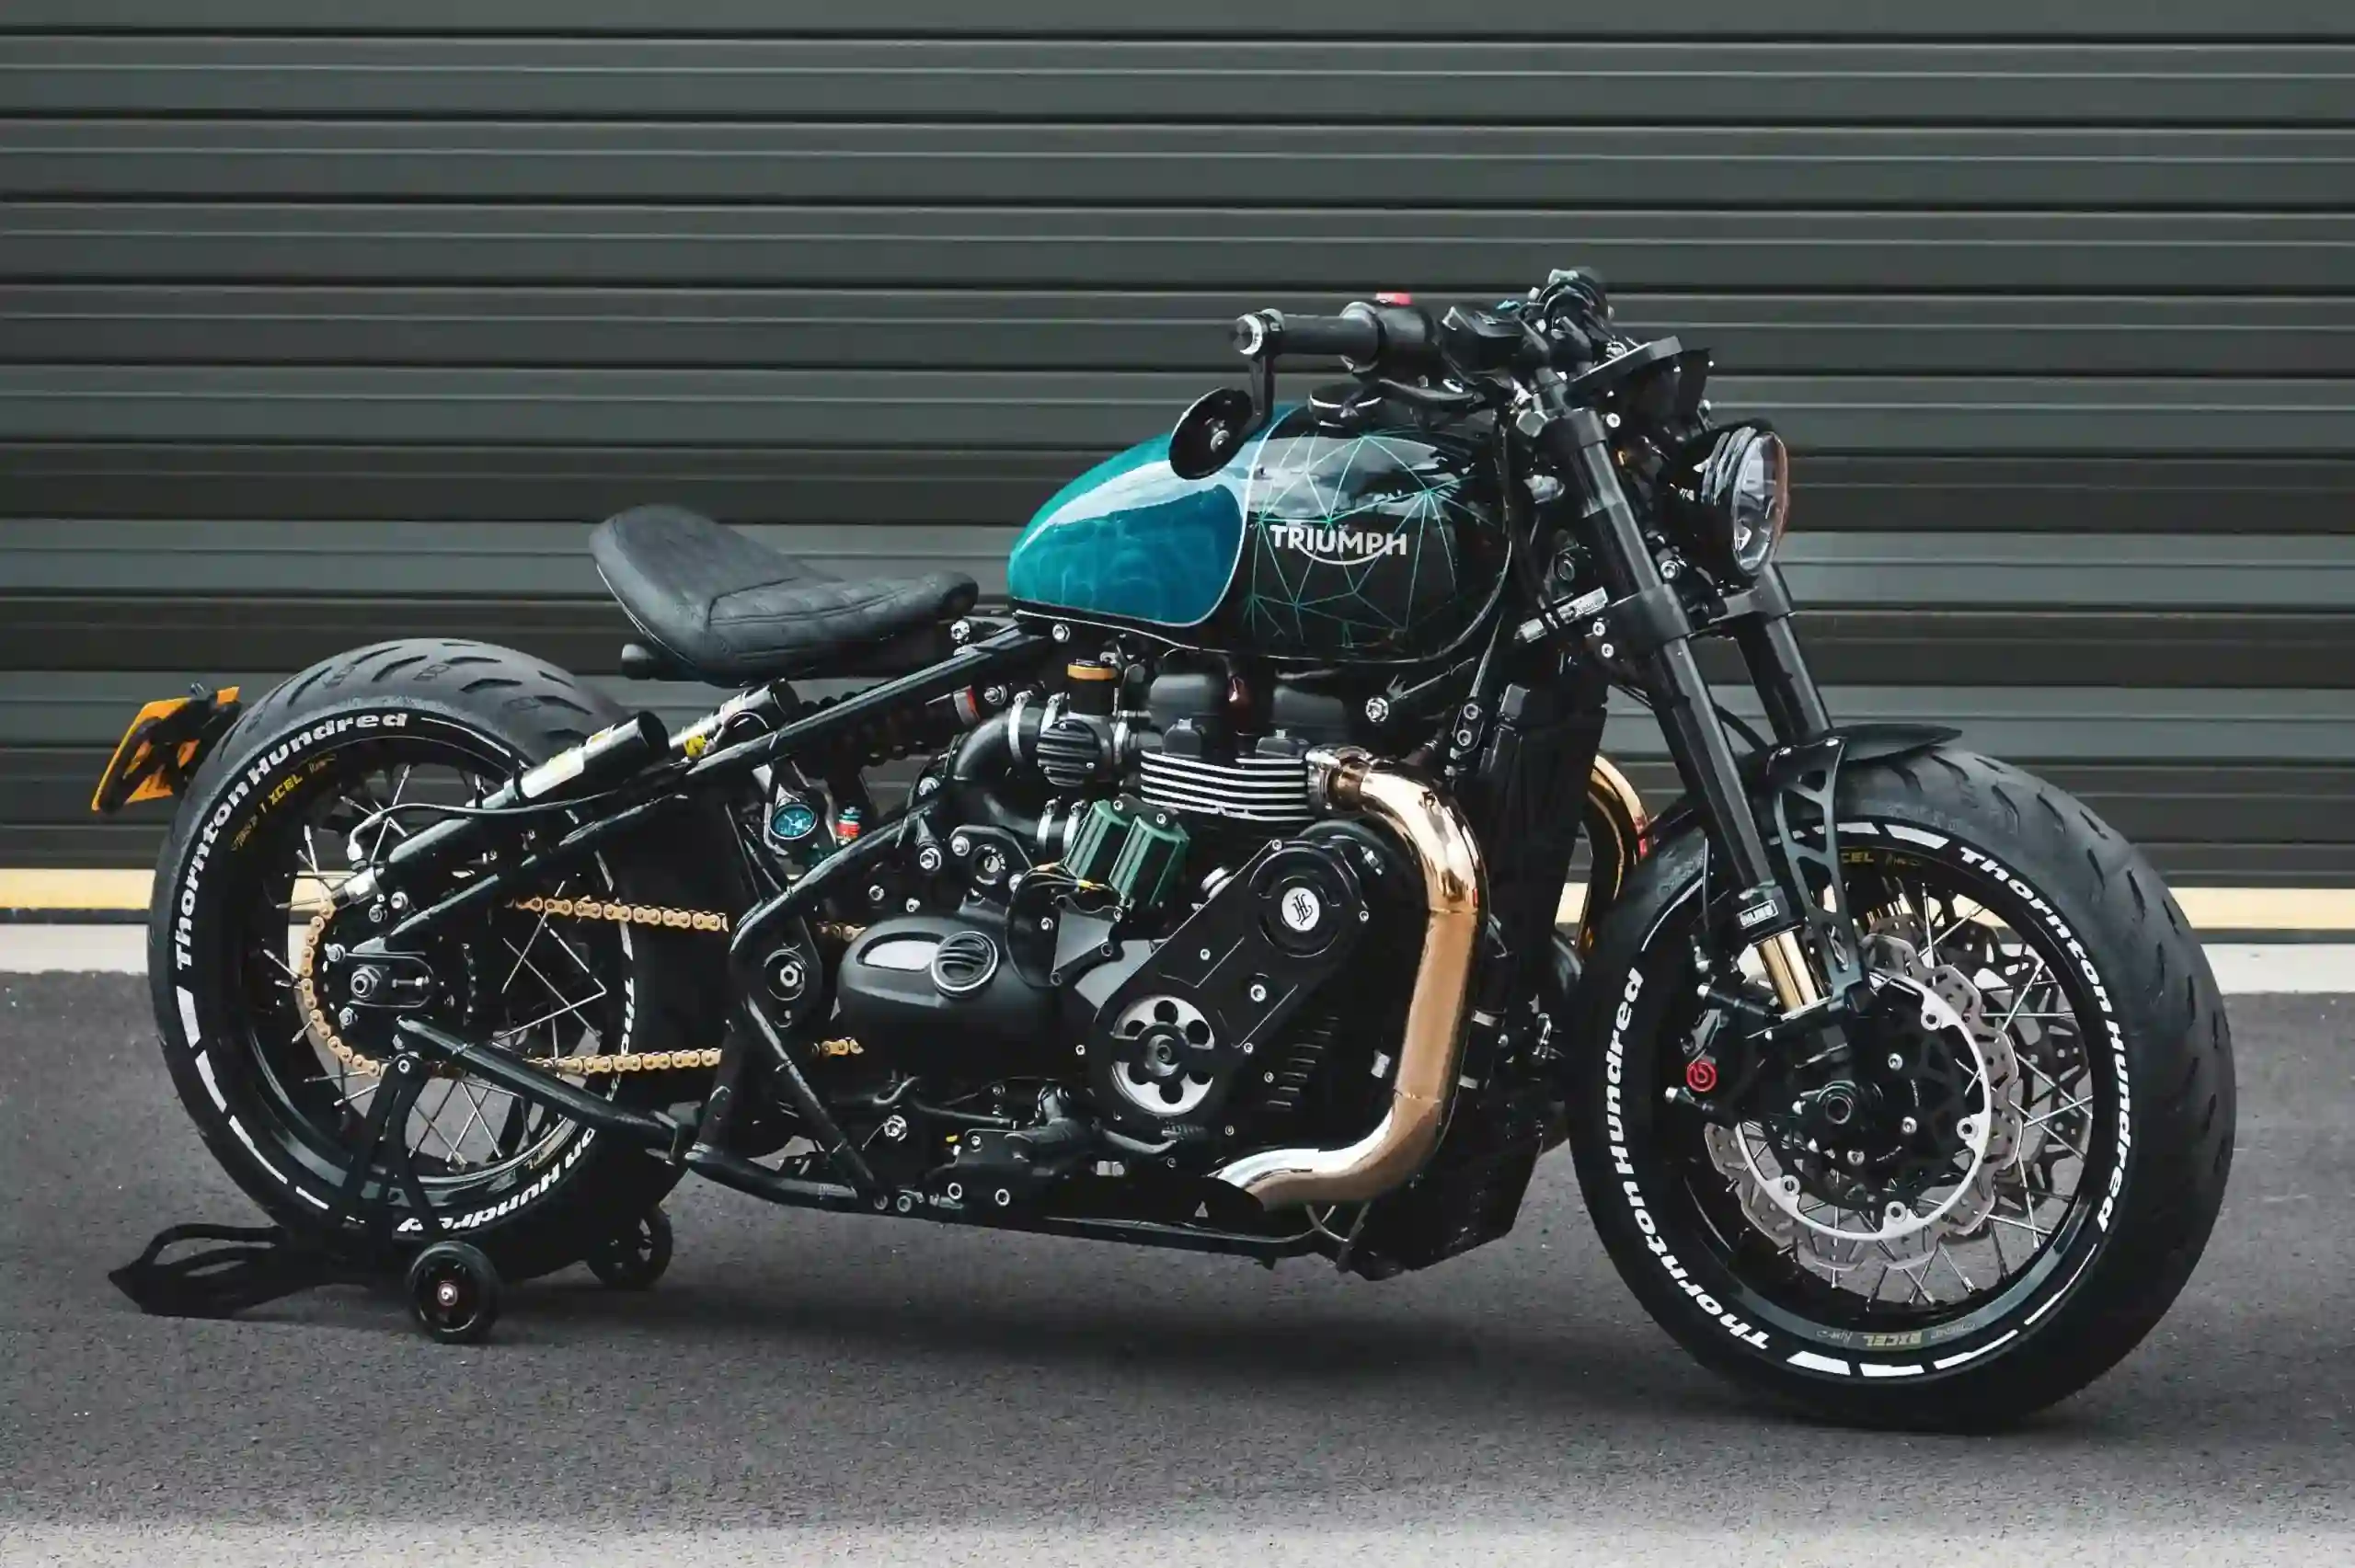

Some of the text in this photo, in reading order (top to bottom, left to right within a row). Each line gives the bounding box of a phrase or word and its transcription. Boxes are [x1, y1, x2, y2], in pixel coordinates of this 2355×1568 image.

[1269, 523, 1407, 564] TRIUMPH
[175, 712, 408, 971] Thornton Hundred
[1604, 966, 1771, 1351] Thornton Hundred
[1959, 845, 2132, 1233] Thornton Hundred
